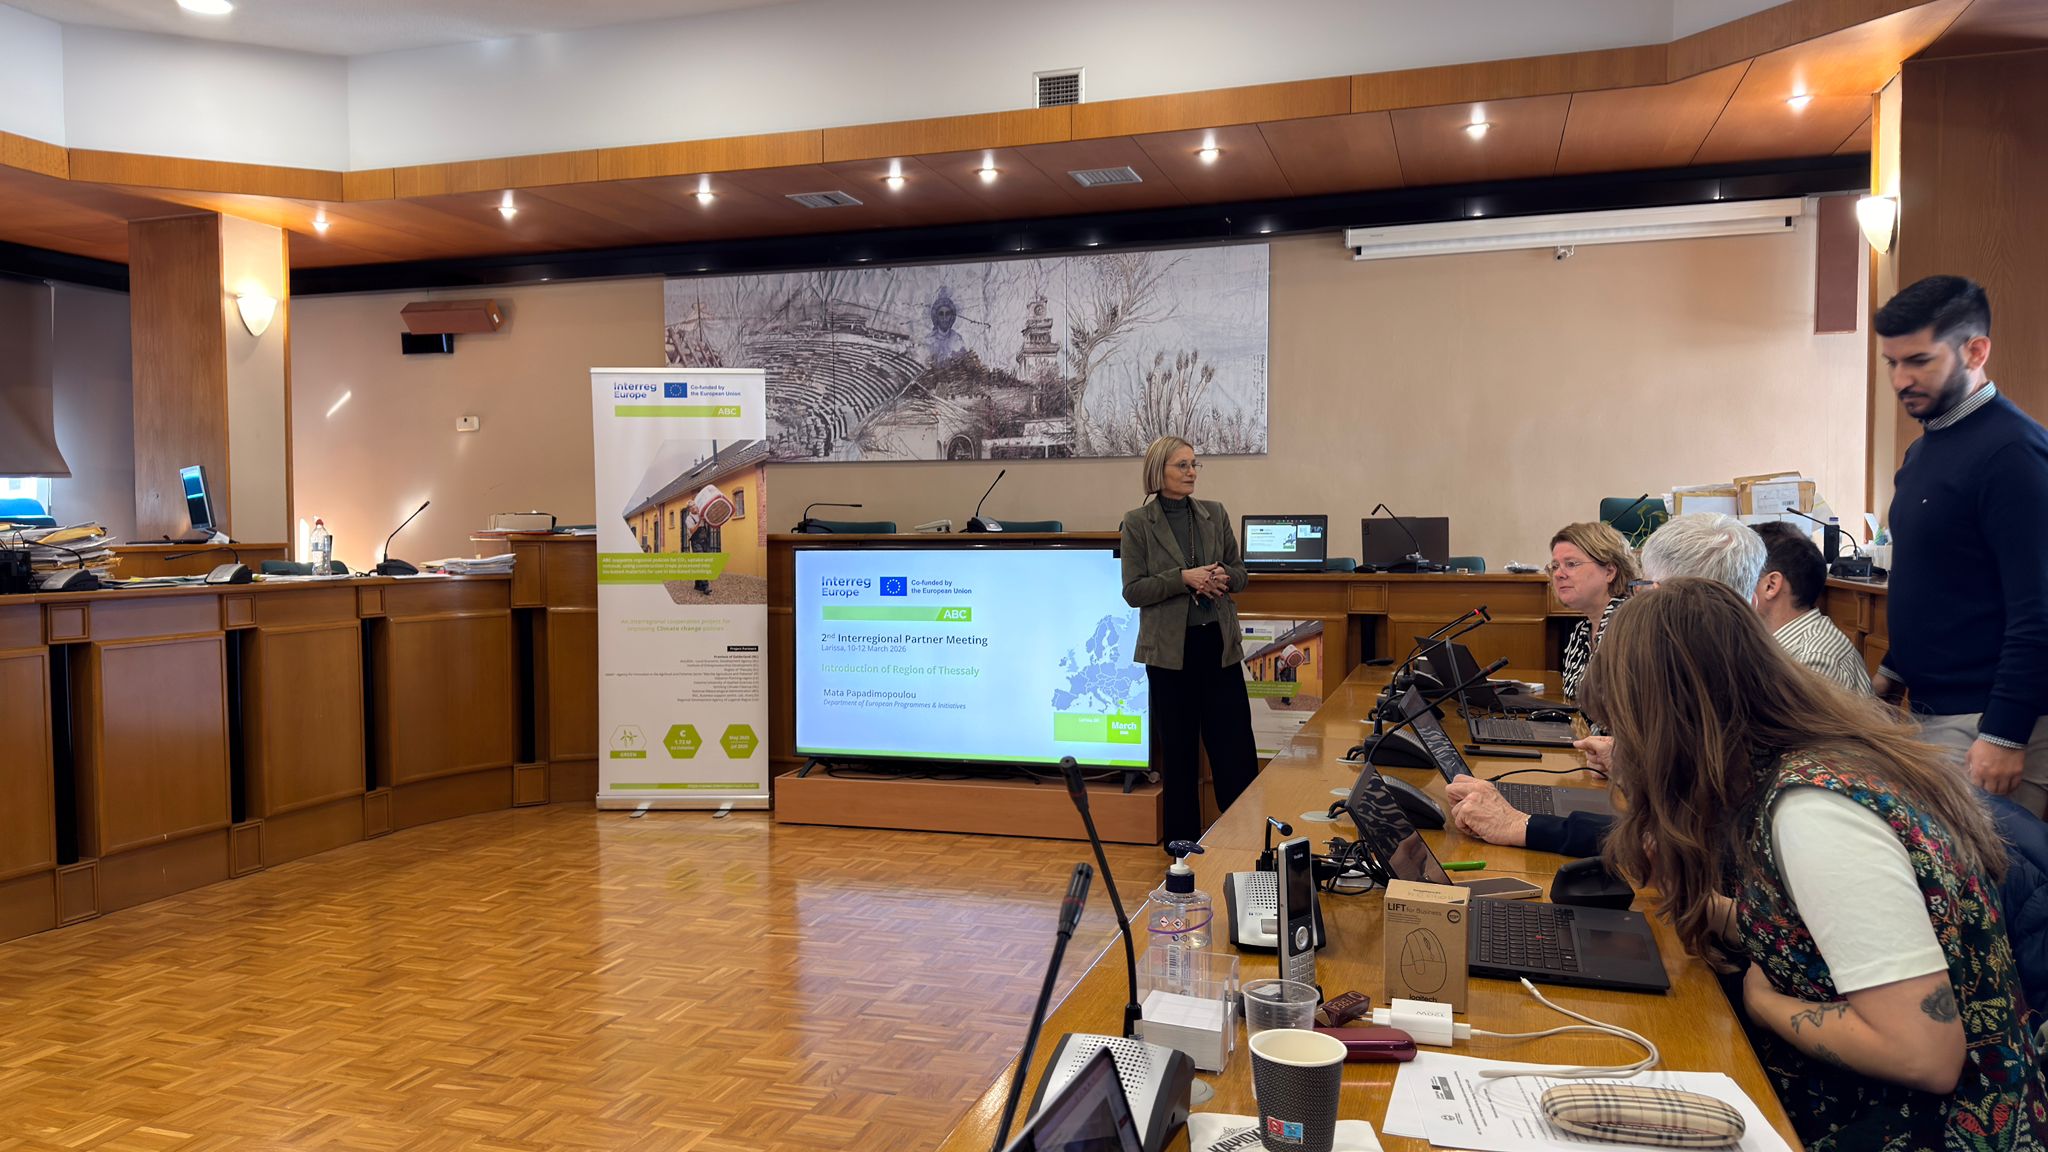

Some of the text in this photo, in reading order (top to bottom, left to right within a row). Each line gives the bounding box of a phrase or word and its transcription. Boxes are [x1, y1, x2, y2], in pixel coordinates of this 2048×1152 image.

[614, 382, 657, 392] Interreg
[614, 391, 647, 400] Europe
[718, 407, 737, 415] ABC
[821, 576, 871, 589] Interreg
[944, 579, 953, 587] by
[822, 588, 860, 598] Europe
[943, 609, 967, 620] ABC
[821, 633, 988, 647] 2nd Interregional Partner Meeting
[821, 645, 847, 653] Larissa,
[867, 645, 889, 653] March
[890, 645, 907, 653] 2026
[822, 664, 980, 678] Introduction of Region of Thessaly
[823, 689, 917, 699] Mata Papadimopoulou
[823, 699, 860, 708] Department
[859, 700, 866, 708] of
[865, 700, 893, 708] European
[894, 701, 931, 709] Programmes
[938, 701, 966, 709] Initiatives
[1111, 721, 1137, 730] March
[1387, 902, 1406, 912] LIFT
[1409, 993, 1438, 1002] logitech
